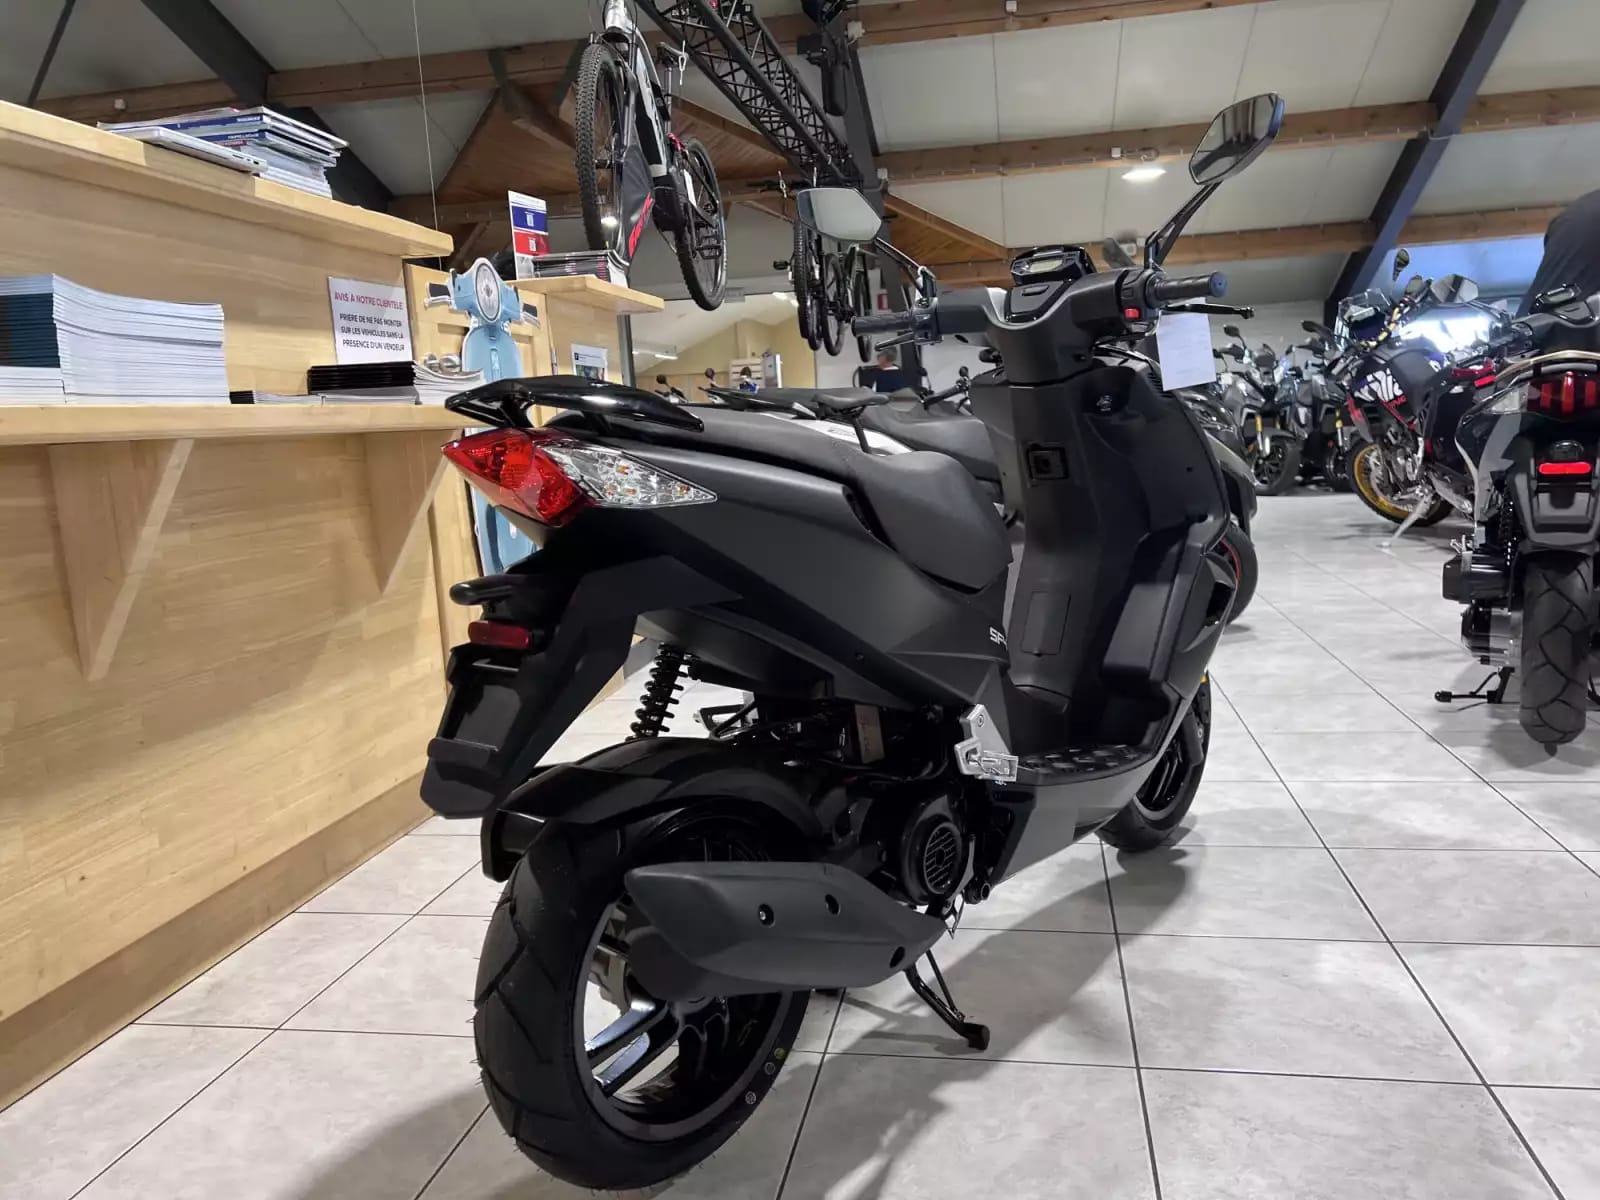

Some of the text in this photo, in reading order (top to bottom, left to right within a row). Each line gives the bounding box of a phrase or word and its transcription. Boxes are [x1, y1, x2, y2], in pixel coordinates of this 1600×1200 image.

[335, 292, 349, 302] AVIS
[356, 295, 376, 306] NOTRE
[377, 298, 404, 310] CLIENTELE
[359, 316, 367, 324] DE
[367, 317, 374, 325] NE
[384, 319, 403, 328] MONTER
[371, 342, 383, 350] D'UN
[384, 343, 406, 352] VENDEUR
